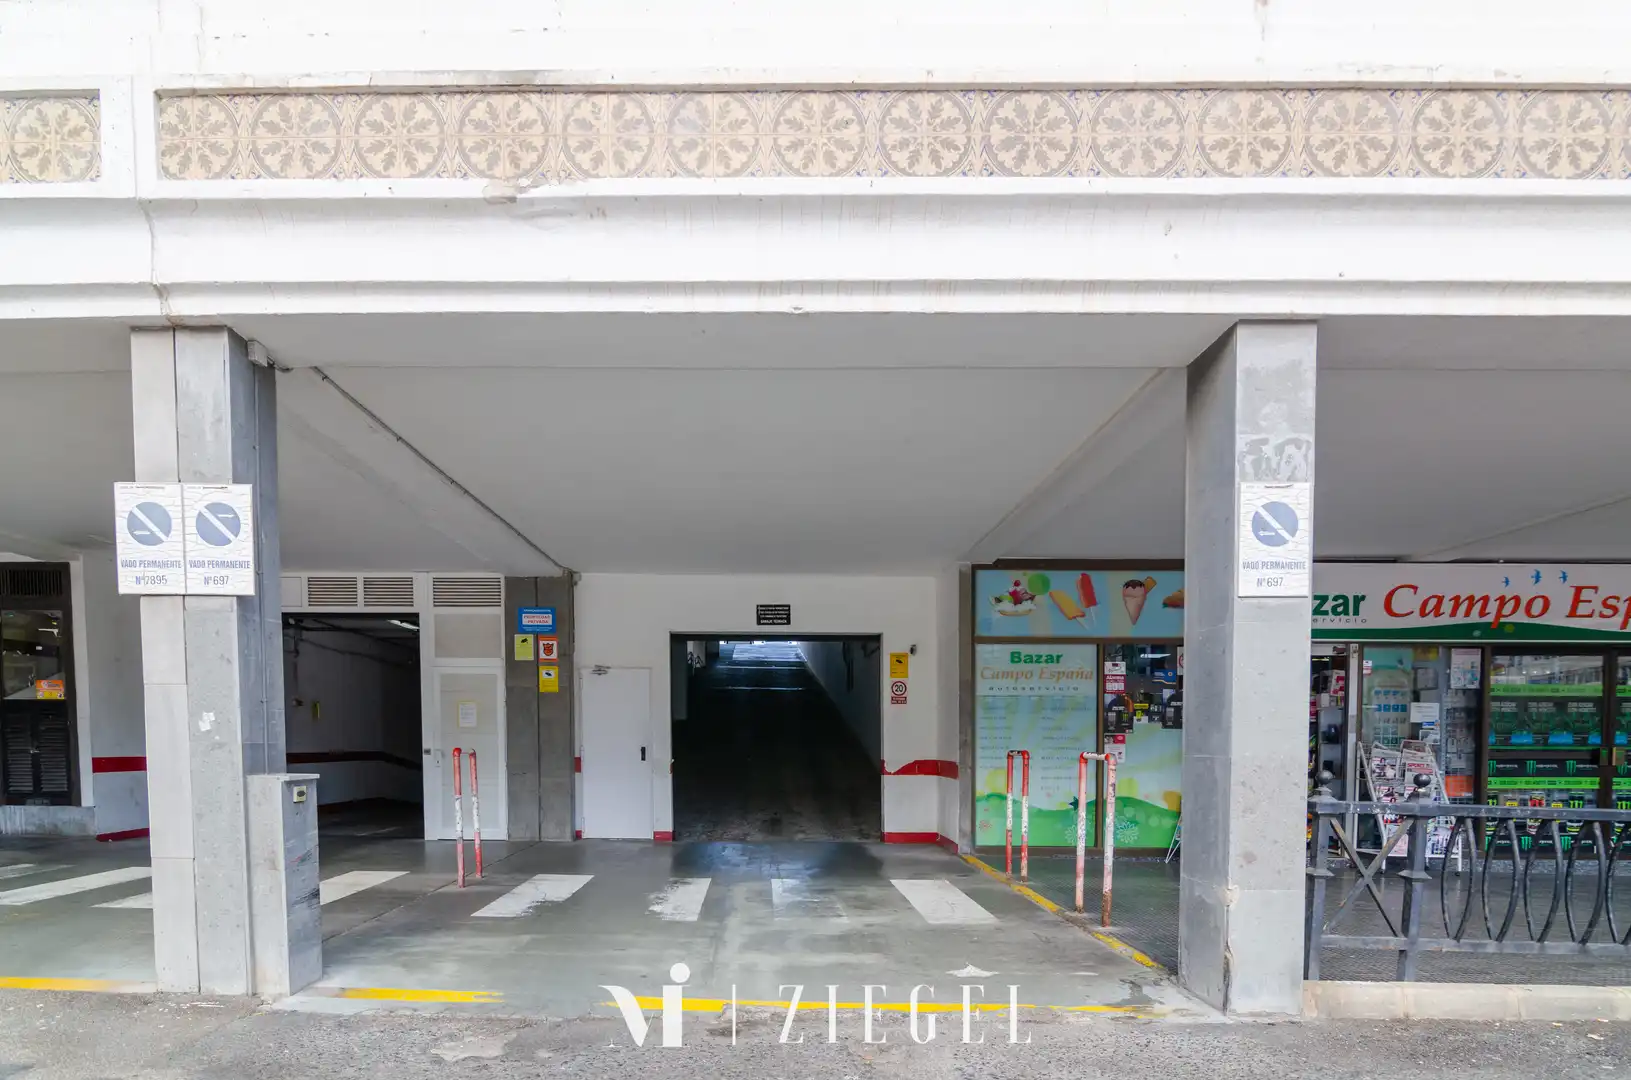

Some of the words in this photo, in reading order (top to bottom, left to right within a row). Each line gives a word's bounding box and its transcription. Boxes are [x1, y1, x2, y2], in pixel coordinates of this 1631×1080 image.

[121, 560, 137, 569] VADO
[138, 560, 182, 569] PERMANENTE
[189, 560, 206, 569] VADO
[207, 560, 251, 569] PERMANENTE
[1242, 561, 1260, 570] VADO
[1261, 561, 1307, 570] PERMANENTE
[1312, 594, 1367, 617] zar
[1383, 584, 1551, 629] Campo
[1009, 651, 1064, 665] Bazar
[980, 666, 1034, 684] Campo
[1038, 666, 1094, 684] España
[894, 684, 904, 693] 20
